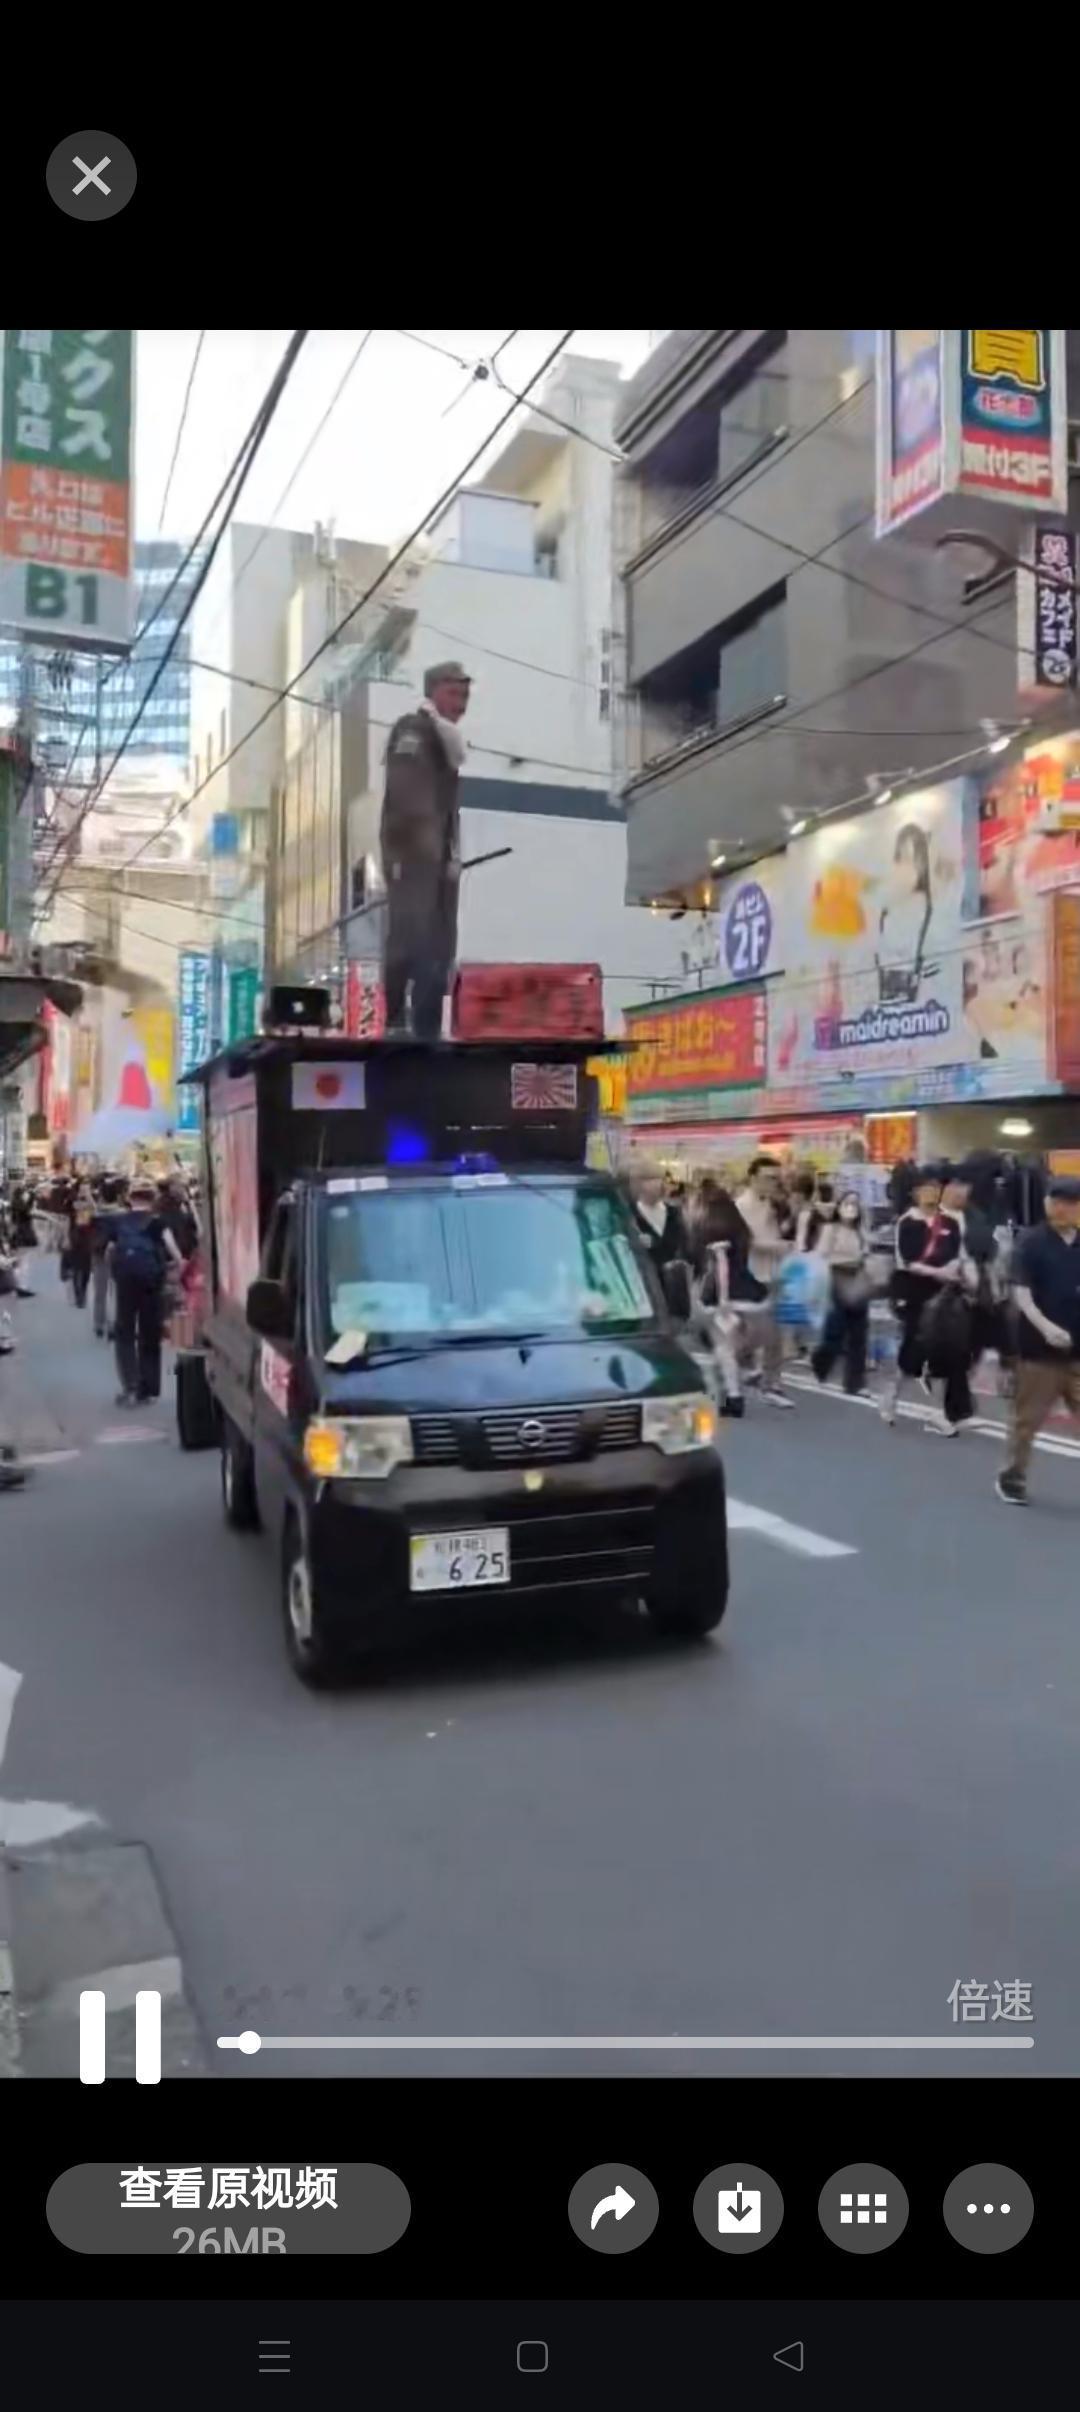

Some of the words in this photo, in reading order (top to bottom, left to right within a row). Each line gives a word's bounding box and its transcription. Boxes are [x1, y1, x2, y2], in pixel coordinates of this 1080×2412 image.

[59, 330, 114, 461] クス
[25, 561, 98, 626] B1
[731, 915, 767, 970] 2F
[839, 1008, 948, 1043] maidreamin
